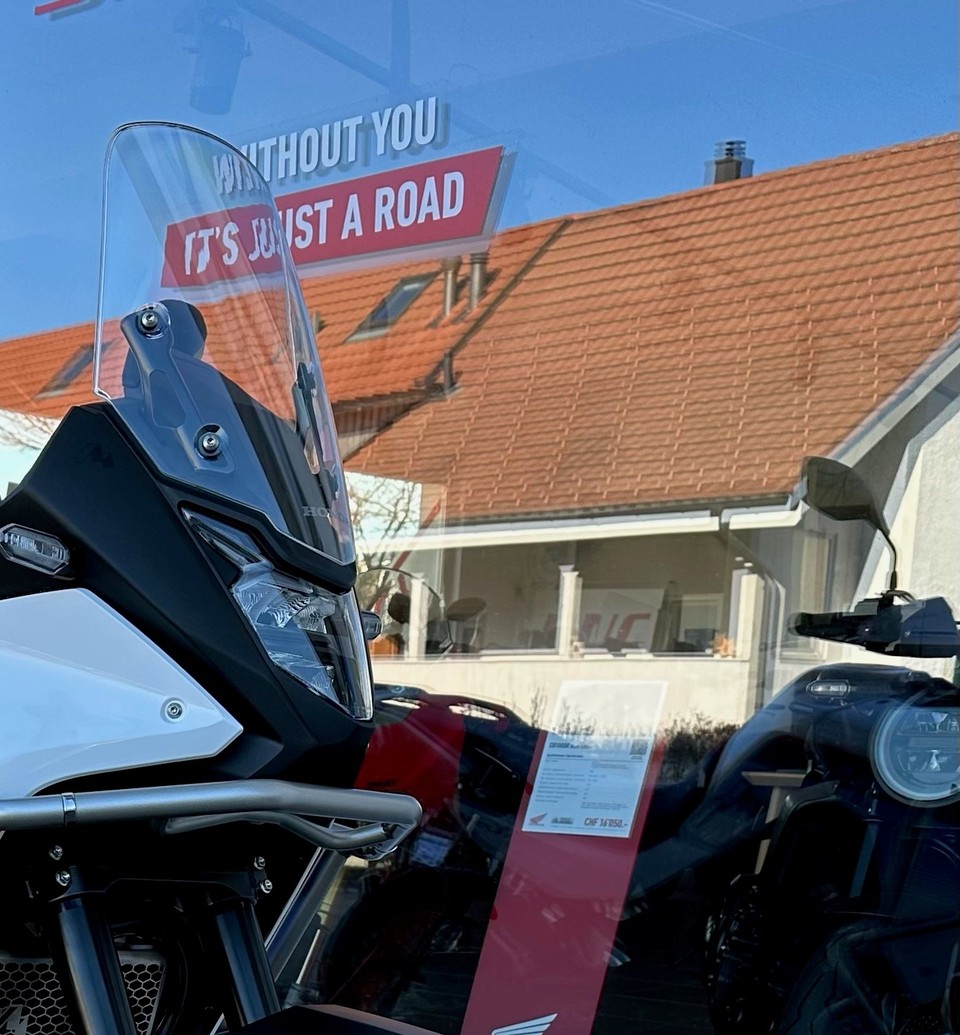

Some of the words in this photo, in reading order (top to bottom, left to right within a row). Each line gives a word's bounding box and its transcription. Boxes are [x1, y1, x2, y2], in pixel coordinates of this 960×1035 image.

[213, 115, 363, 194] WITHOUT
[371, 97, 437, 155] YOU
[184, 222, 239, 275] IT'S
[341, 194, 362, 240] A
[374, 171, 465, 233] ROAD
[584, 817, 599, 827] CHF
